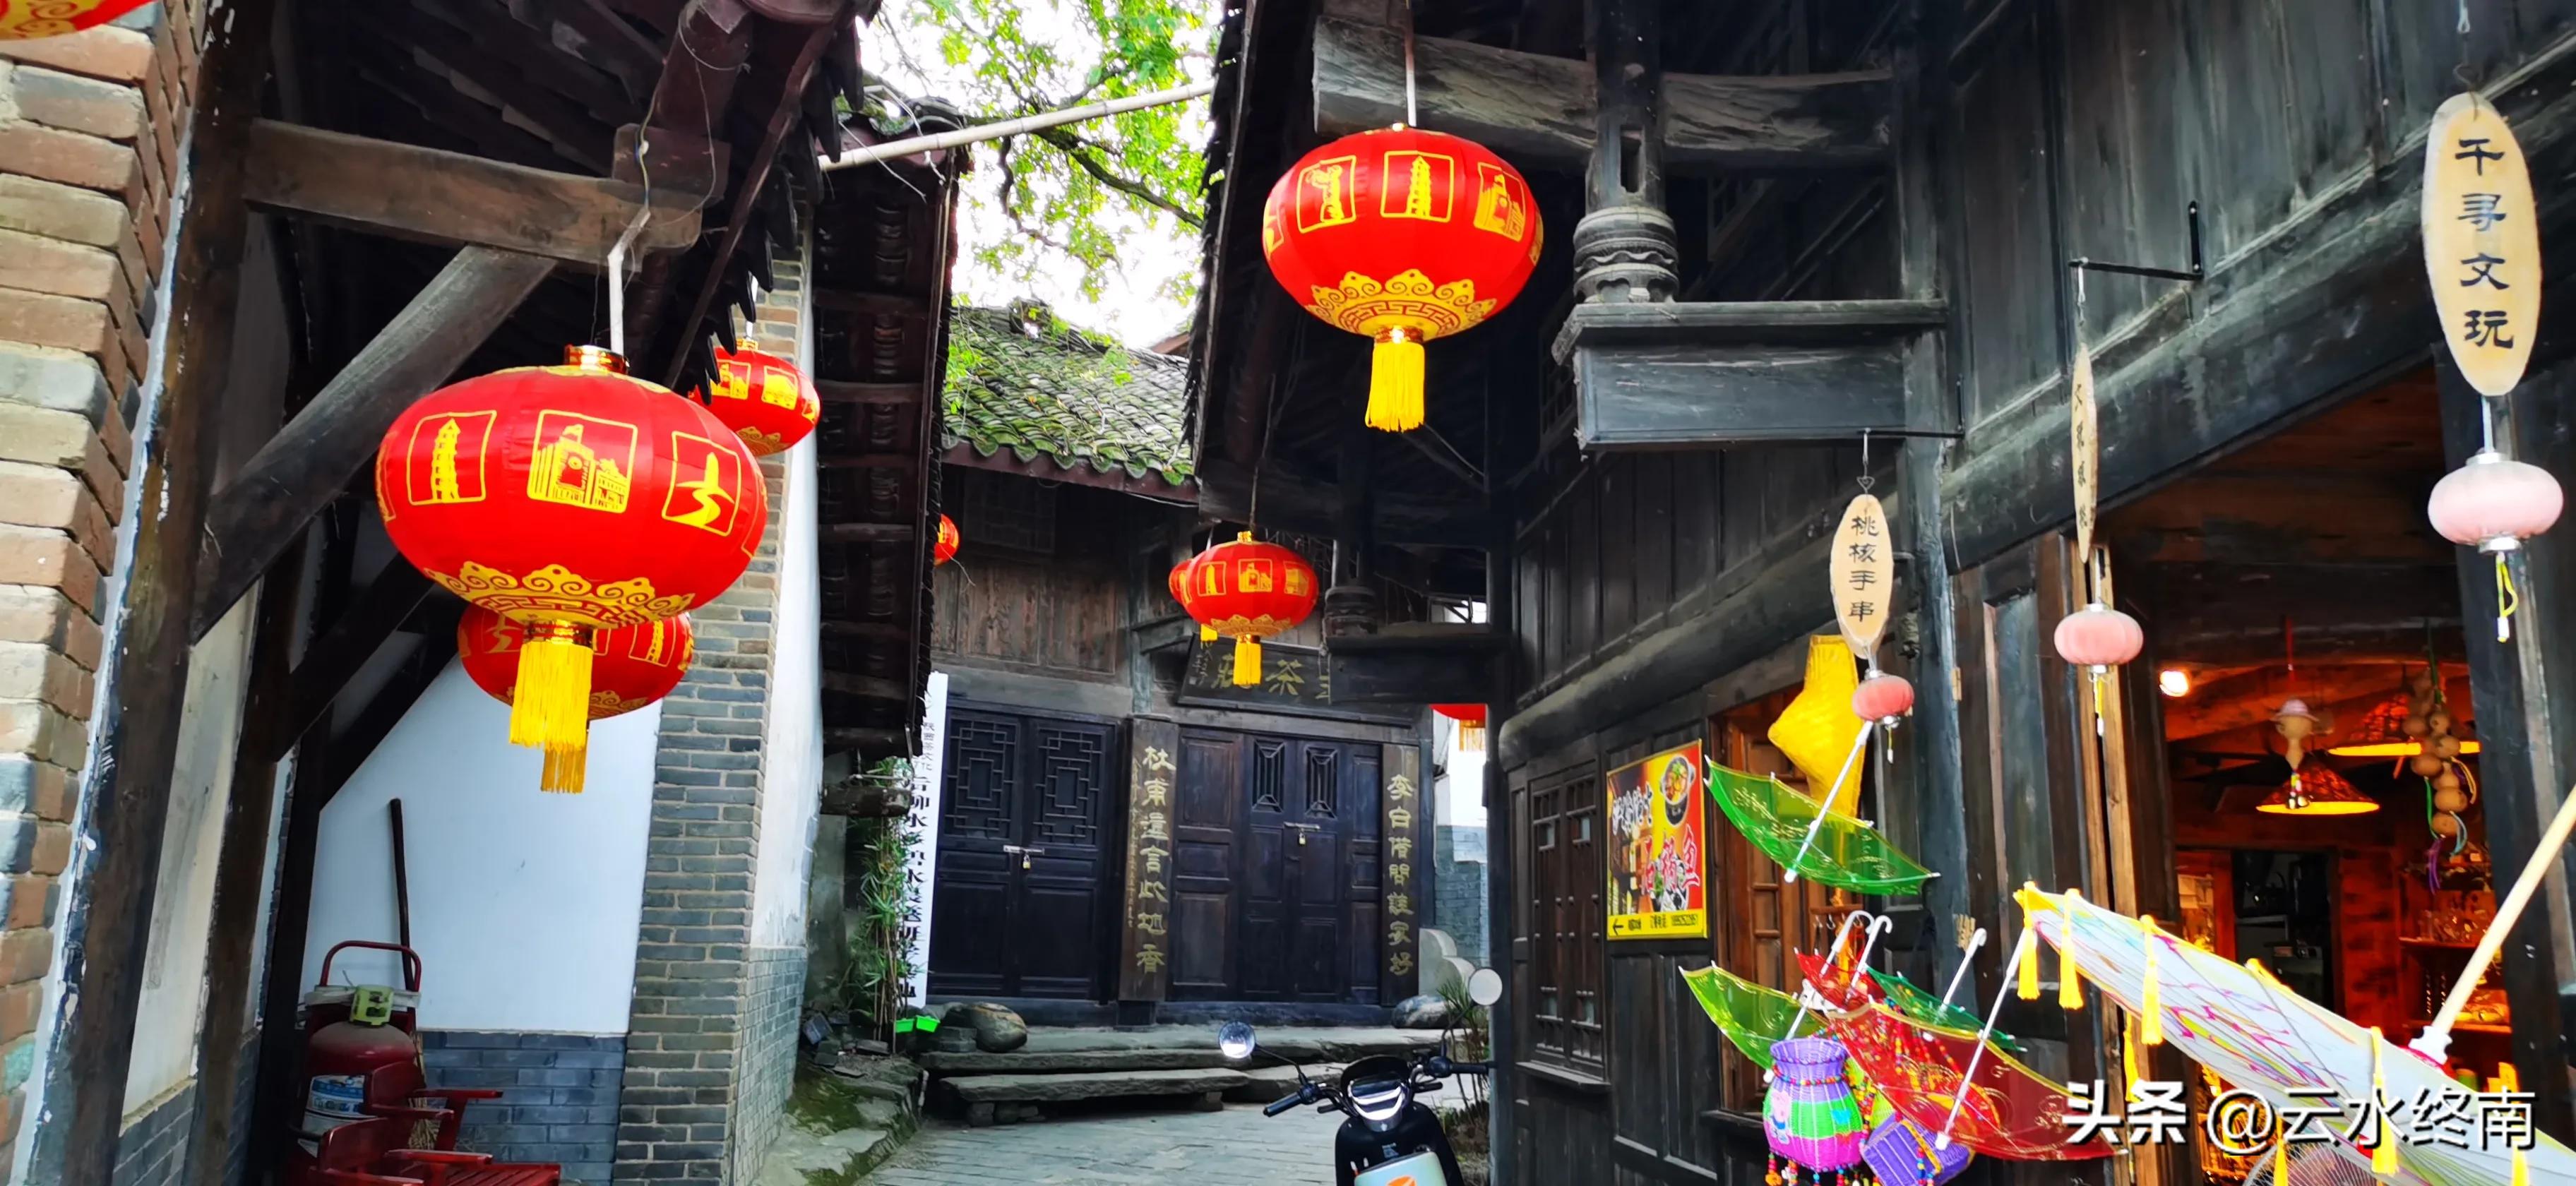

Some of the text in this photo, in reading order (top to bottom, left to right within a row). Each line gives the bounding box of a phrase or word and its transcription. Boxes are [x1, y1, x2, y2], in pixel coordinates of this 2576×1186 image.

[2455, 138, 2515, 349] 千寻文玩
[1848, 515, 1880, 623] 桃核手串
